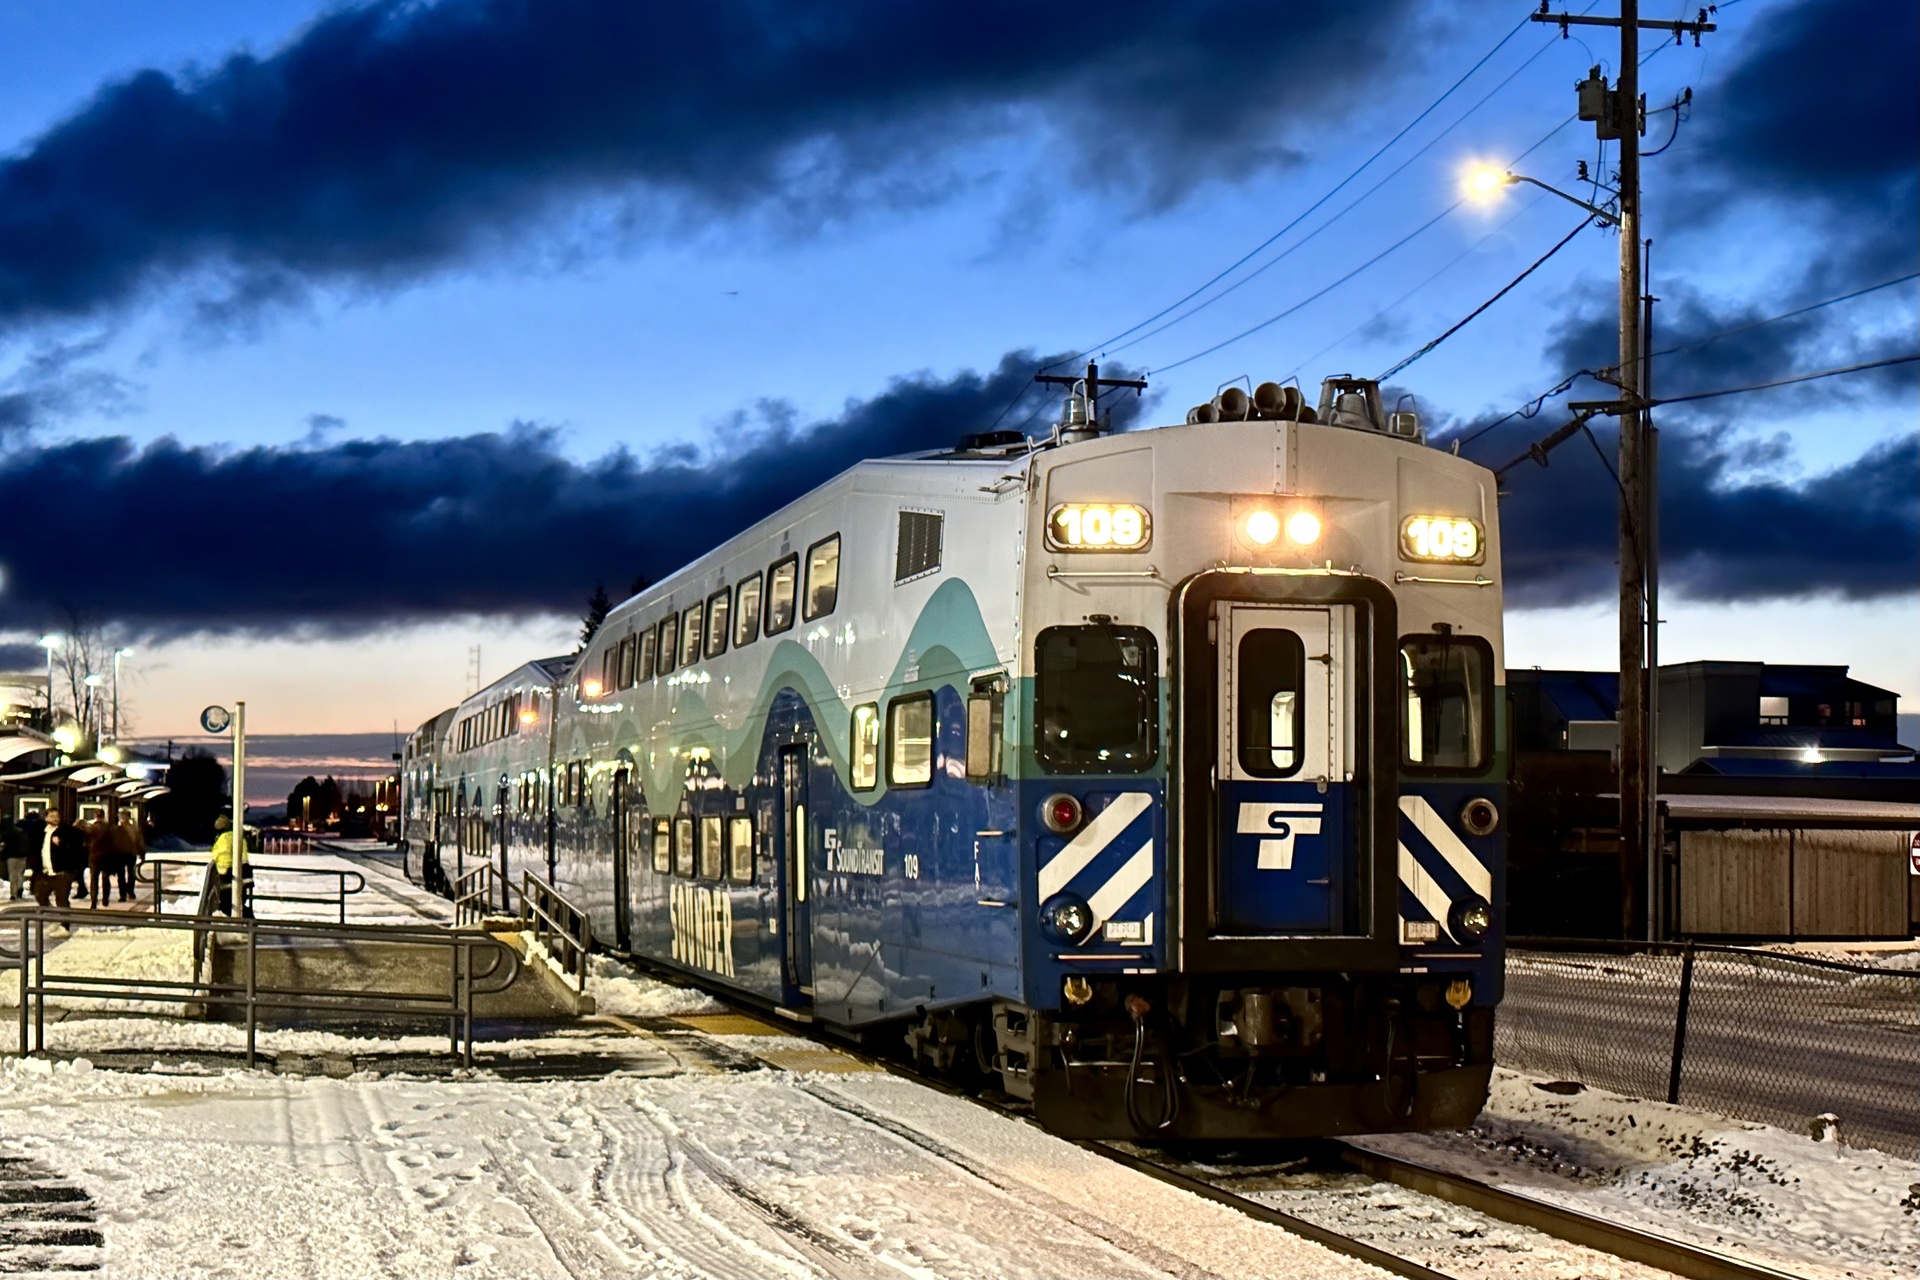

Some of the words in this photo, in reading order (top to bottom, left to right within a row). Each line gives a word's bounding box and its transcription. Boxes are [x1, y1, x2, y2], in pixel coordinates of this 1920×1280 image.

[1057, 509, 1141, 545] 109
[1407, 520, 1477, 557] 109
[904, 854, 919, 879] 109
[670, 884, 734, 978] SOUNDER
